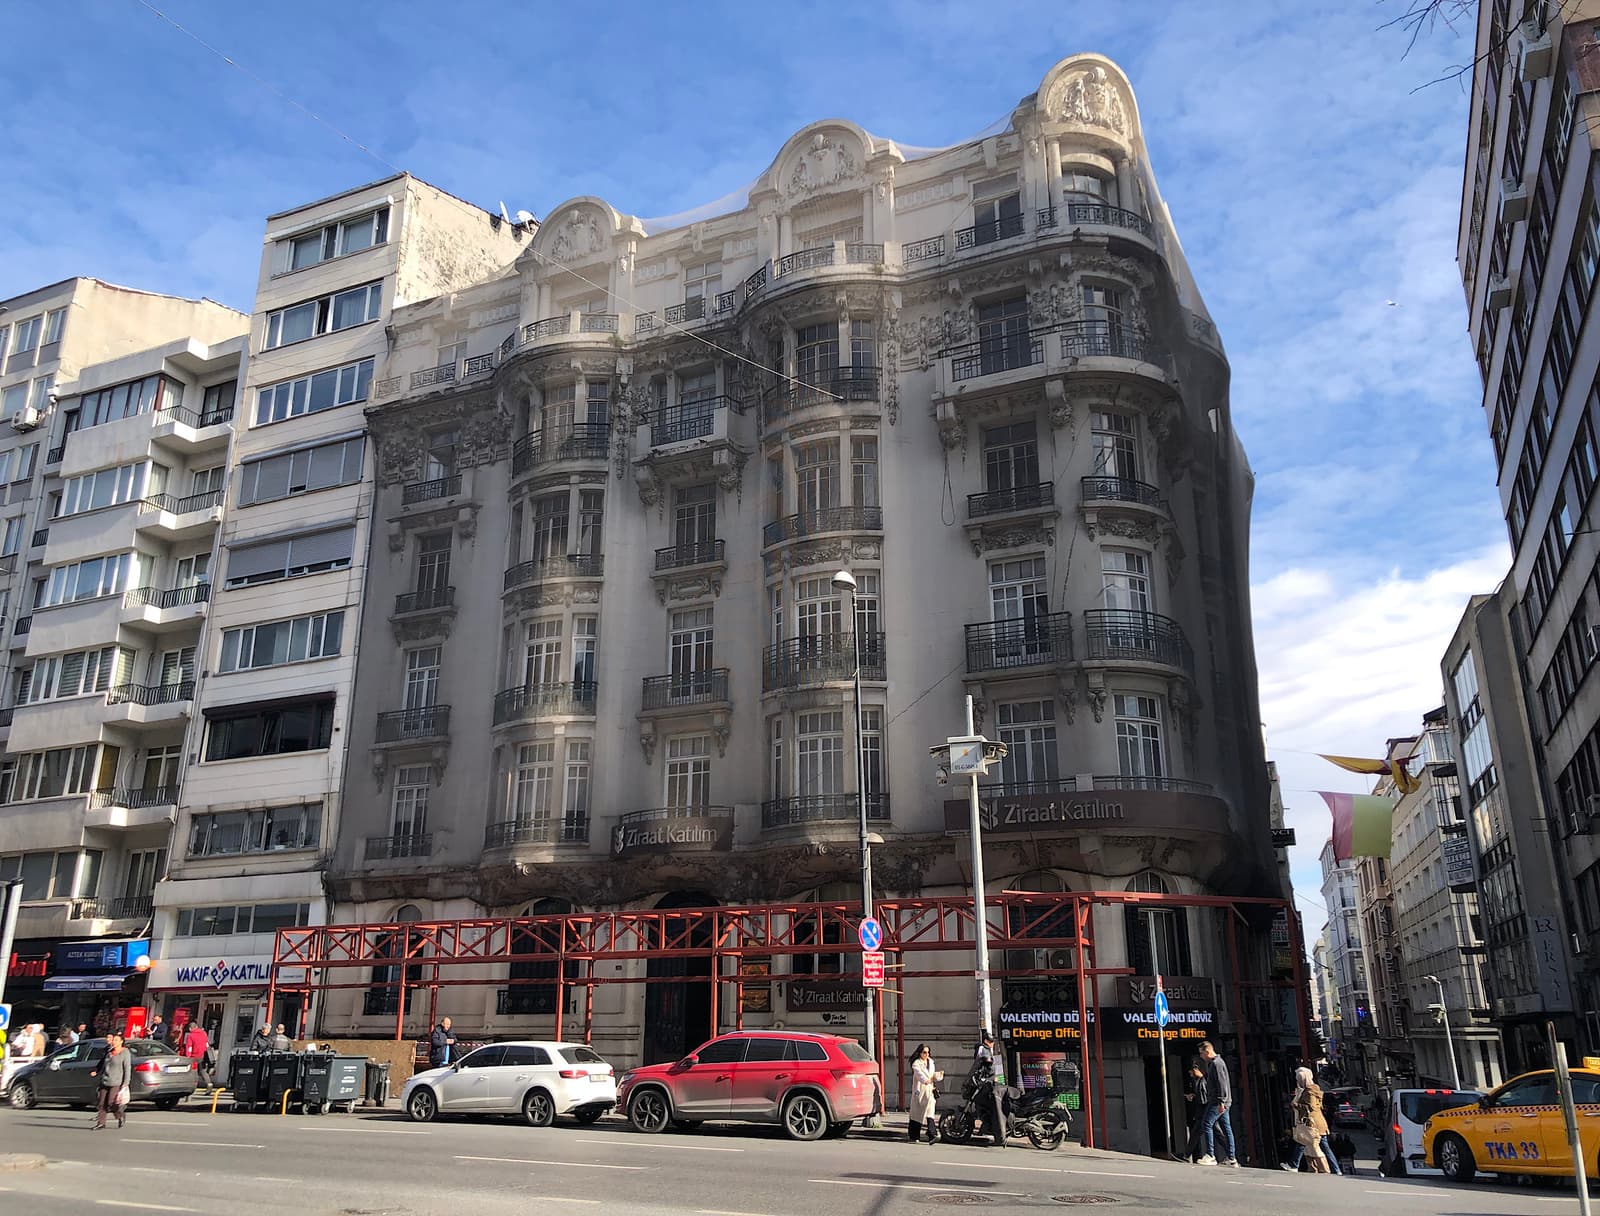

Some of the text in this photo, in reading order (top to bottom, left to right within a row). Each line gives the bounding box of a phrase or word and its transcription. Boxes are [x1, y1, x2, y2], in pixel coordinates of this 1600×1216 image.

[1004, 802, 1057, 824] Ziraat
[626, 827, 663, 847] Ziraat
[177, 966, 210, 981] VAKIF
[806, 991, 834, 1003] Ziraat
[1149, 984, 1185, 999] Zraat
[1000, 1010, 1095, 1023] VALENTİNO DÖİZ
[1012, 1027, 1081, 1039] Change Offic
[1180, 1028, 1206, 1038] Office
[1485, 1142, 1539, 1160] TKA 33
